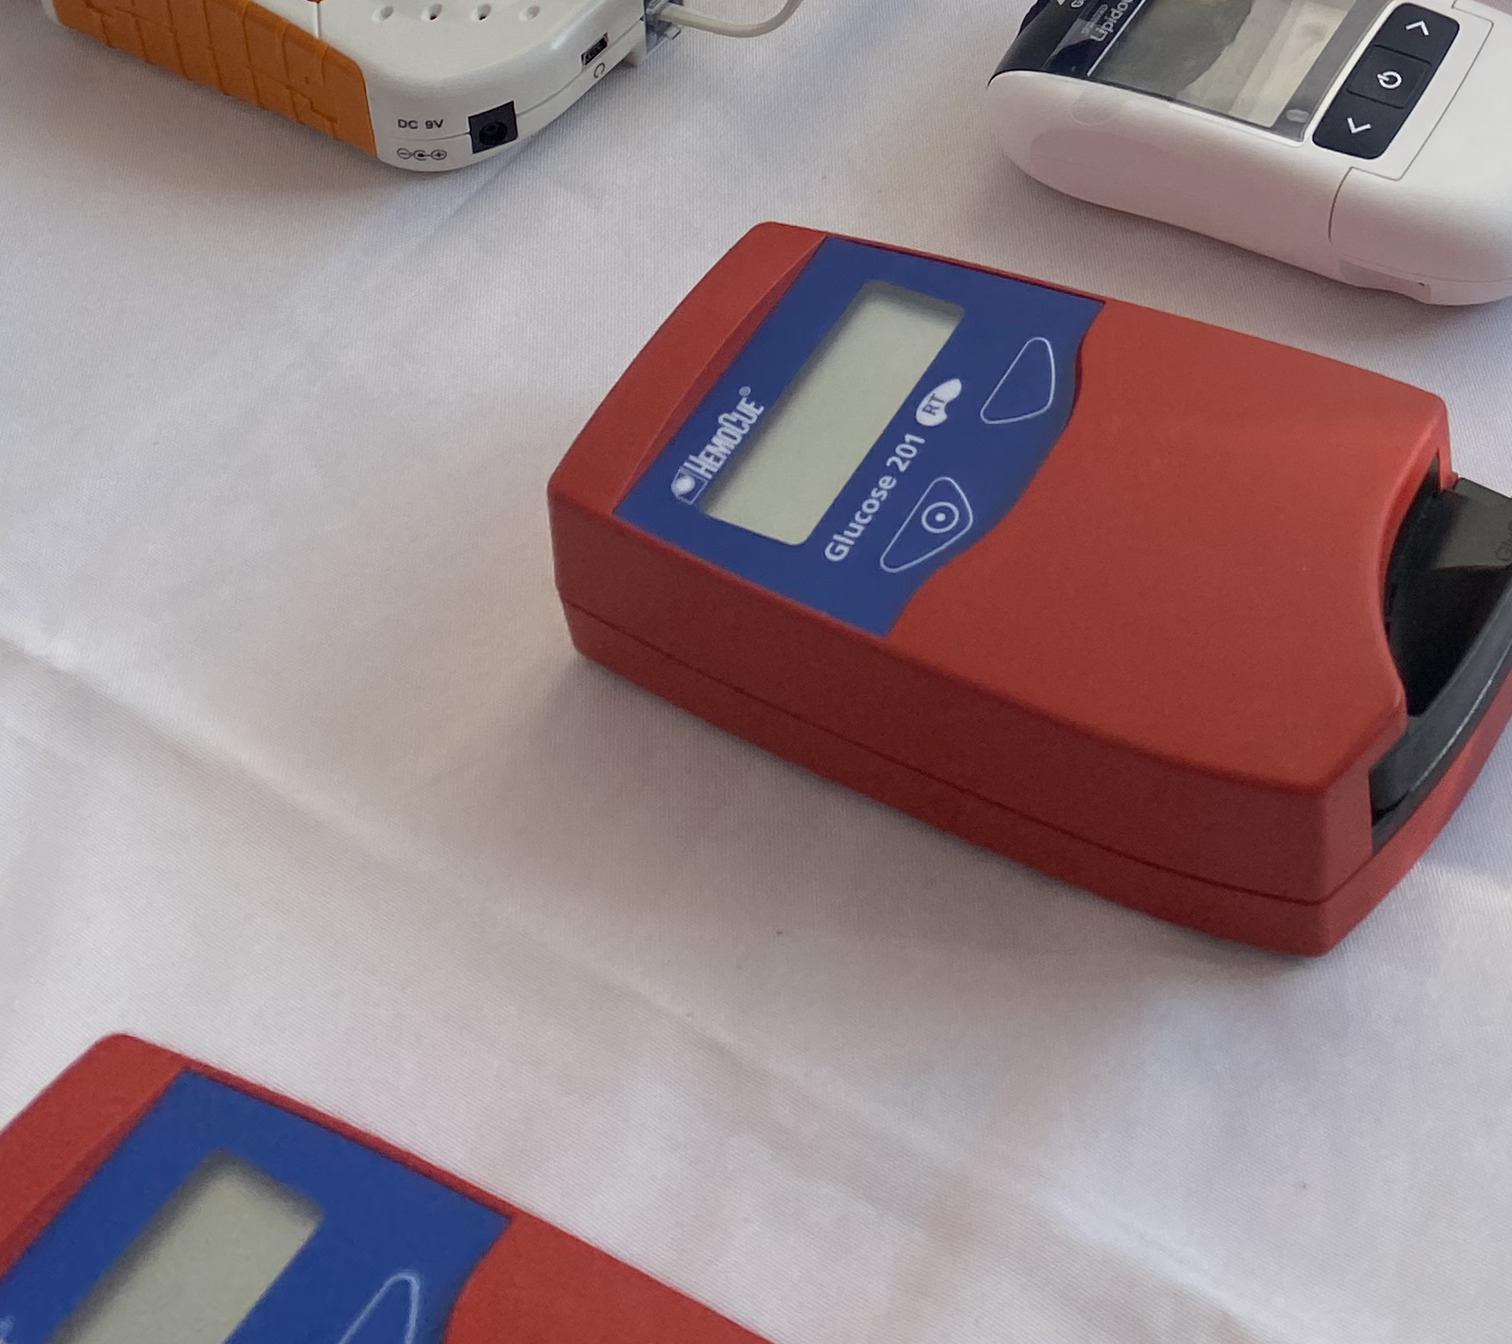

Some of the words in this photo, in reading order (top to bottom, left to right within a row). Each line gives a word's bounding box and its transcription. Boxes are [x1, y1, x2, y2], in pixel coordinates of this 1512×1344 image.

[397, 117, 419, 130] DC
[424, 117, 445, 130] 9V
[922, 392, 948, 417] RT
[684, 396, 766, 481] HEMOCUE
[823, 474, 898, 563] Glucose
[886, 432, 926, 473] 201
